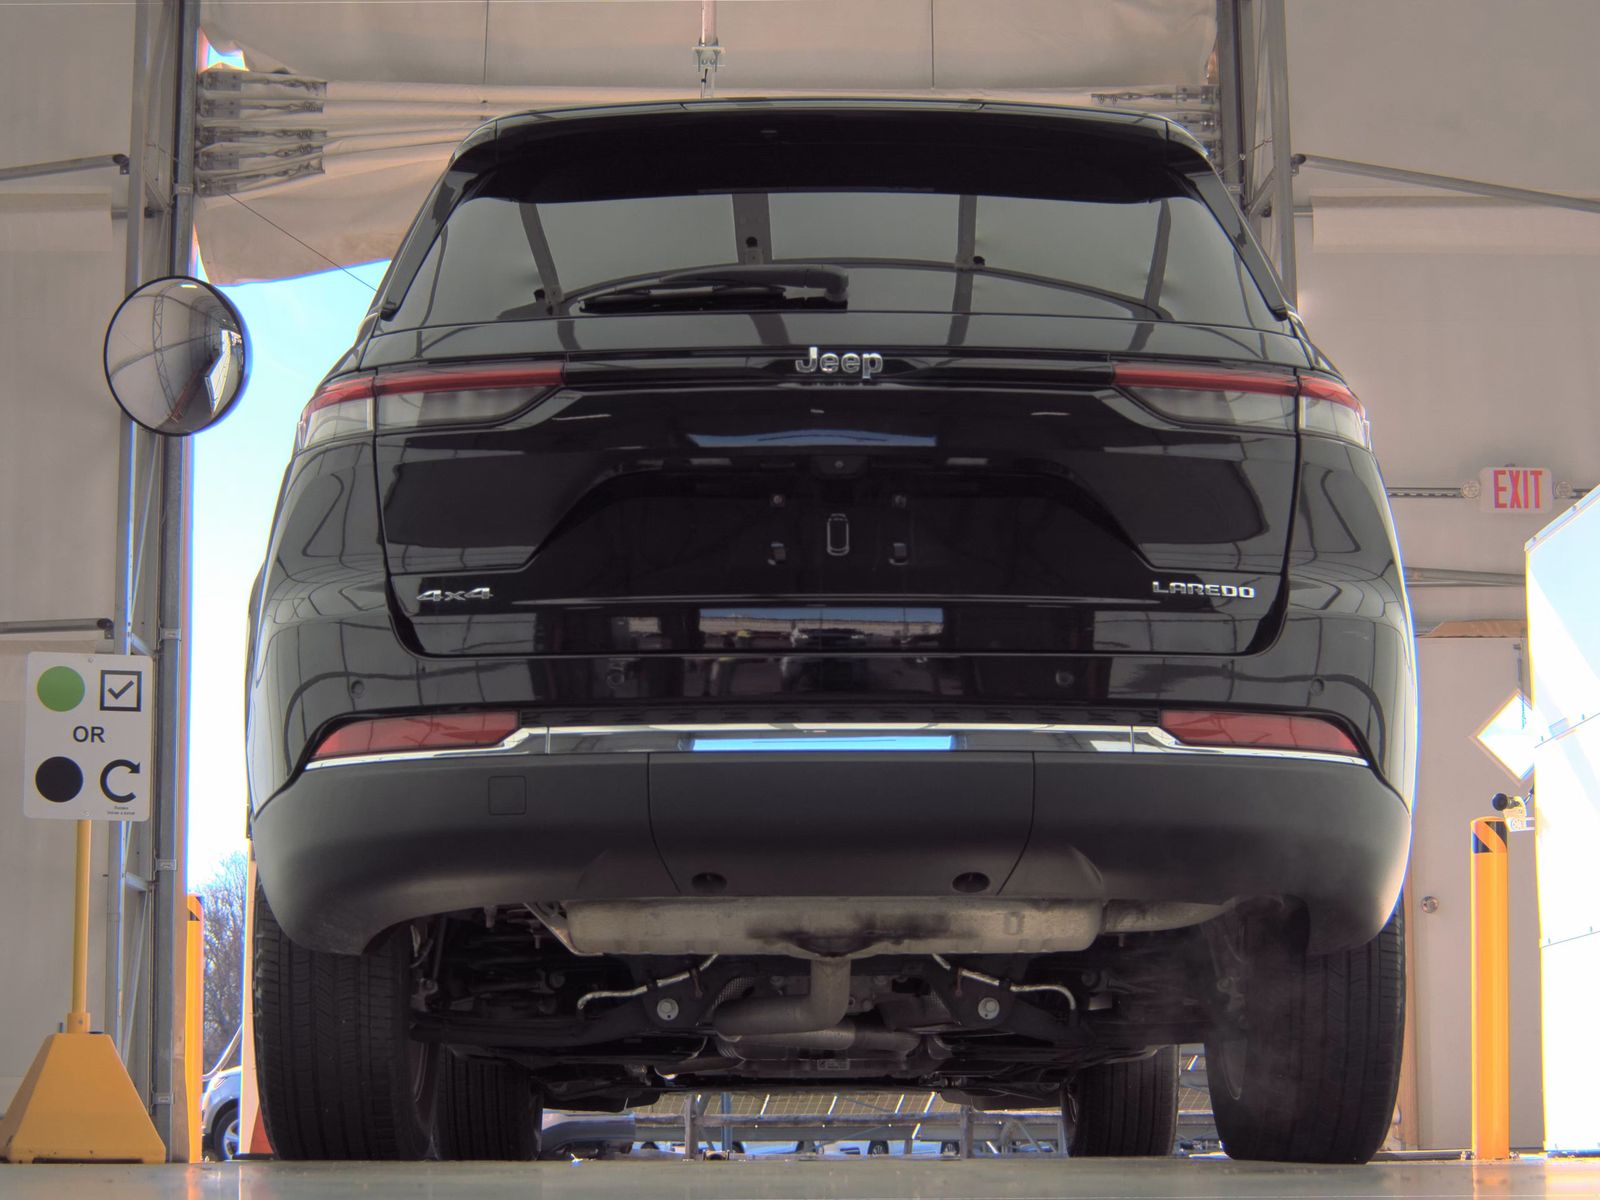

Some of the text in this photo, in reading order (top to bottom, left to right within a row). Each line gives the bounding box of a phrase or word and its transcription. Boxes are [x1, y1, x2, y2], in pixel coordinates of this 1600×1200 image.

[795, 346, 883, 379] Jeep
[1493, 470, 1543, 509] EXIT
[416, 587, 494, 602] 4x4
[1152, 581, 1255, 598] LAREDO
[73, 725, 106, 743] OR
